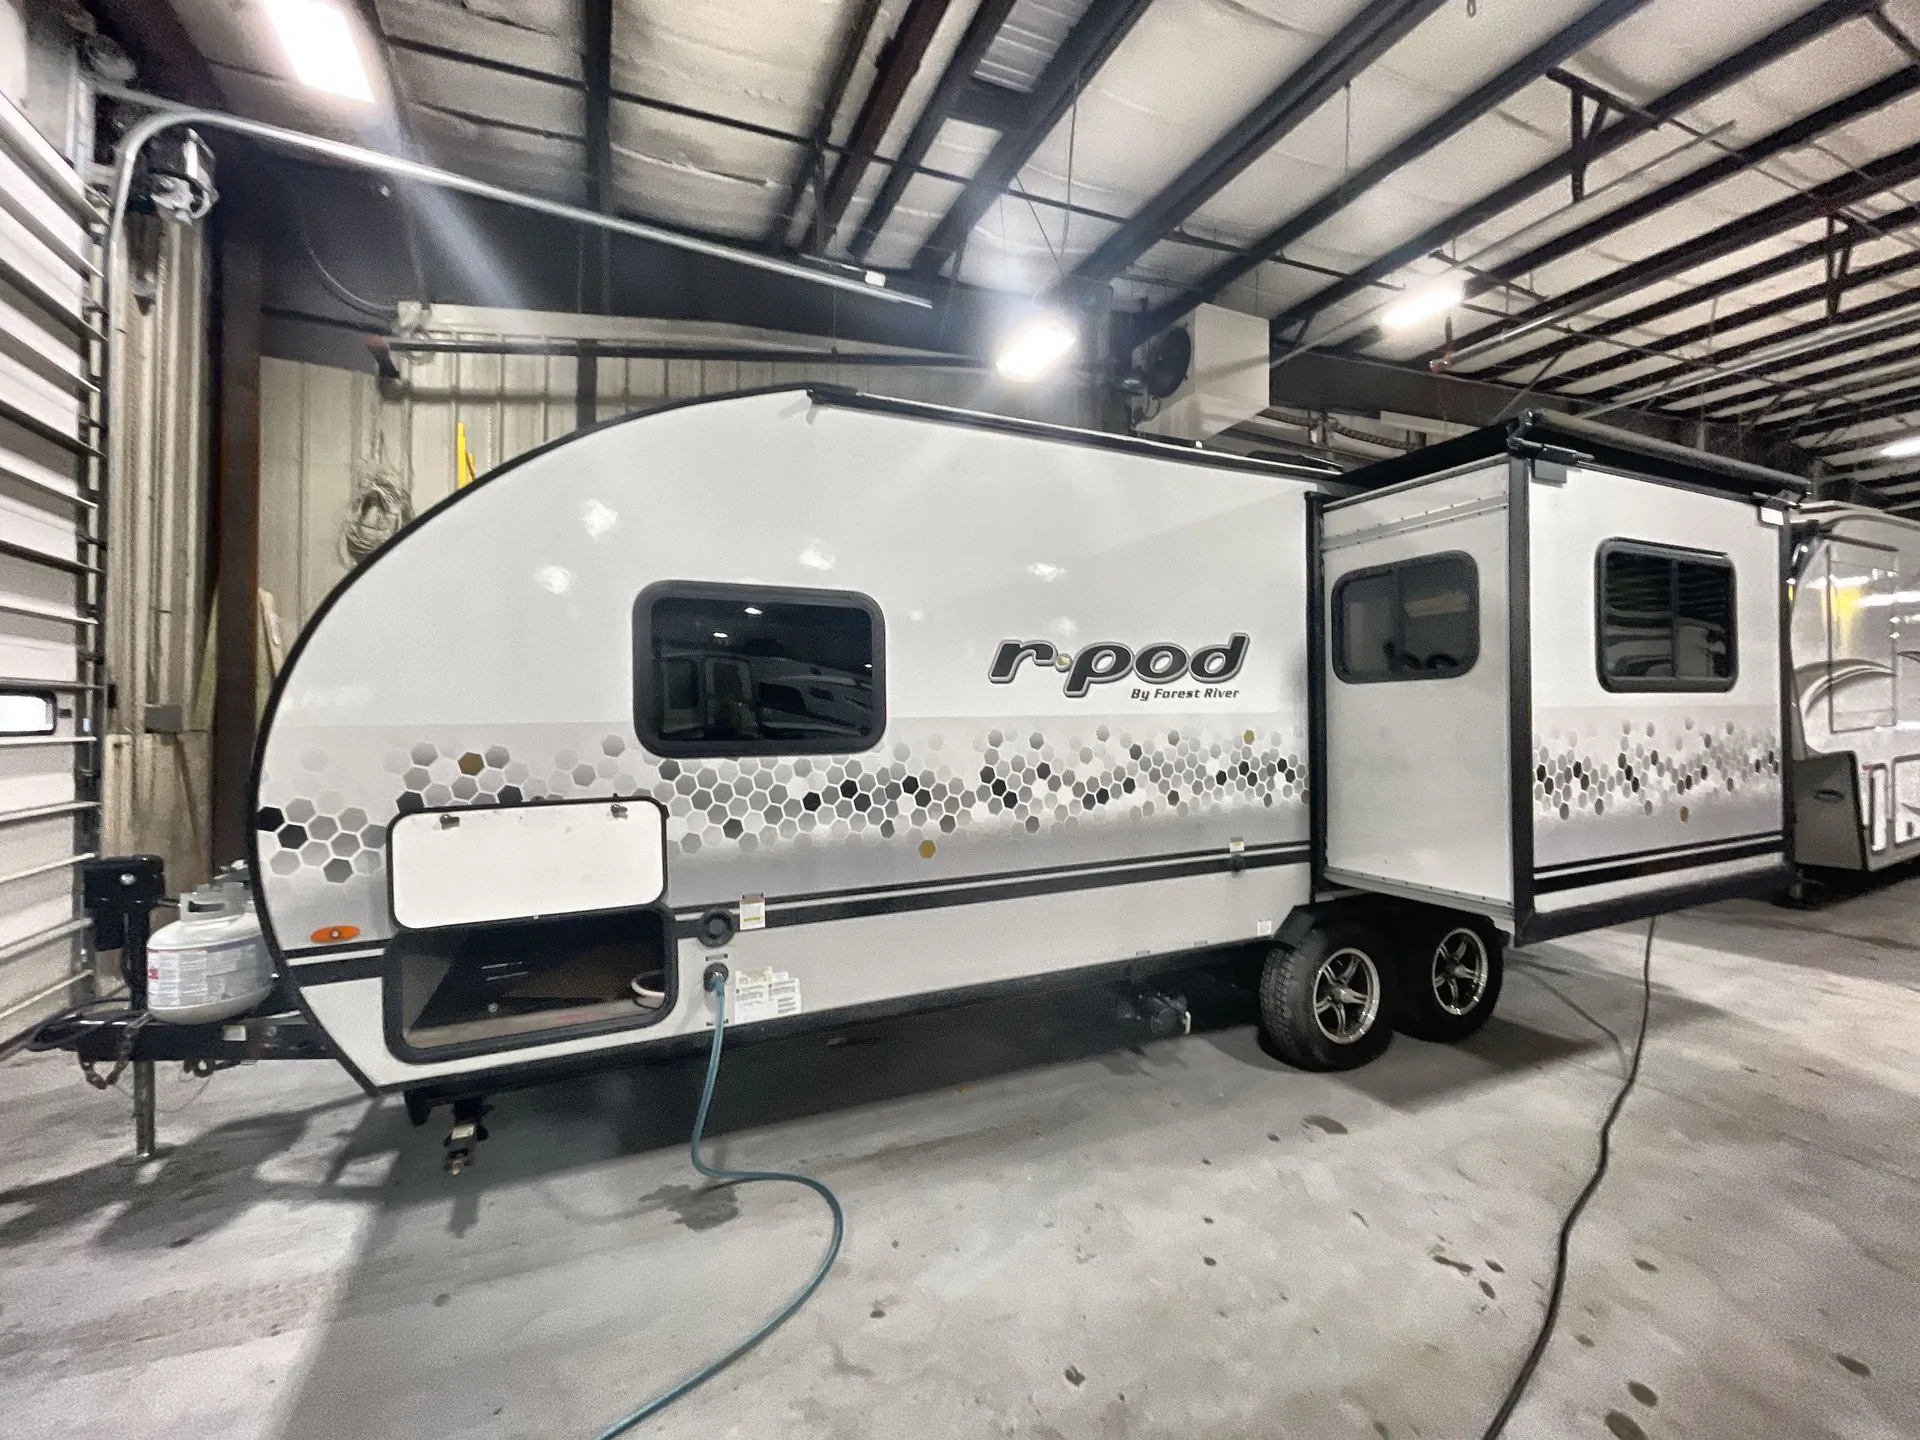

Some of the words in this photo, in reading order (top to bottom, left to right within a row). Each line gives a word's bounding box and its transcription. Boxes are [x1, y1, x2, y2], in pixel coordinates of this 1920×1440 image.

[1130, 688, 1150, 702] By
[1153, 688, 1201, 699] Forest
[1203, 687, 1240, 698] River
